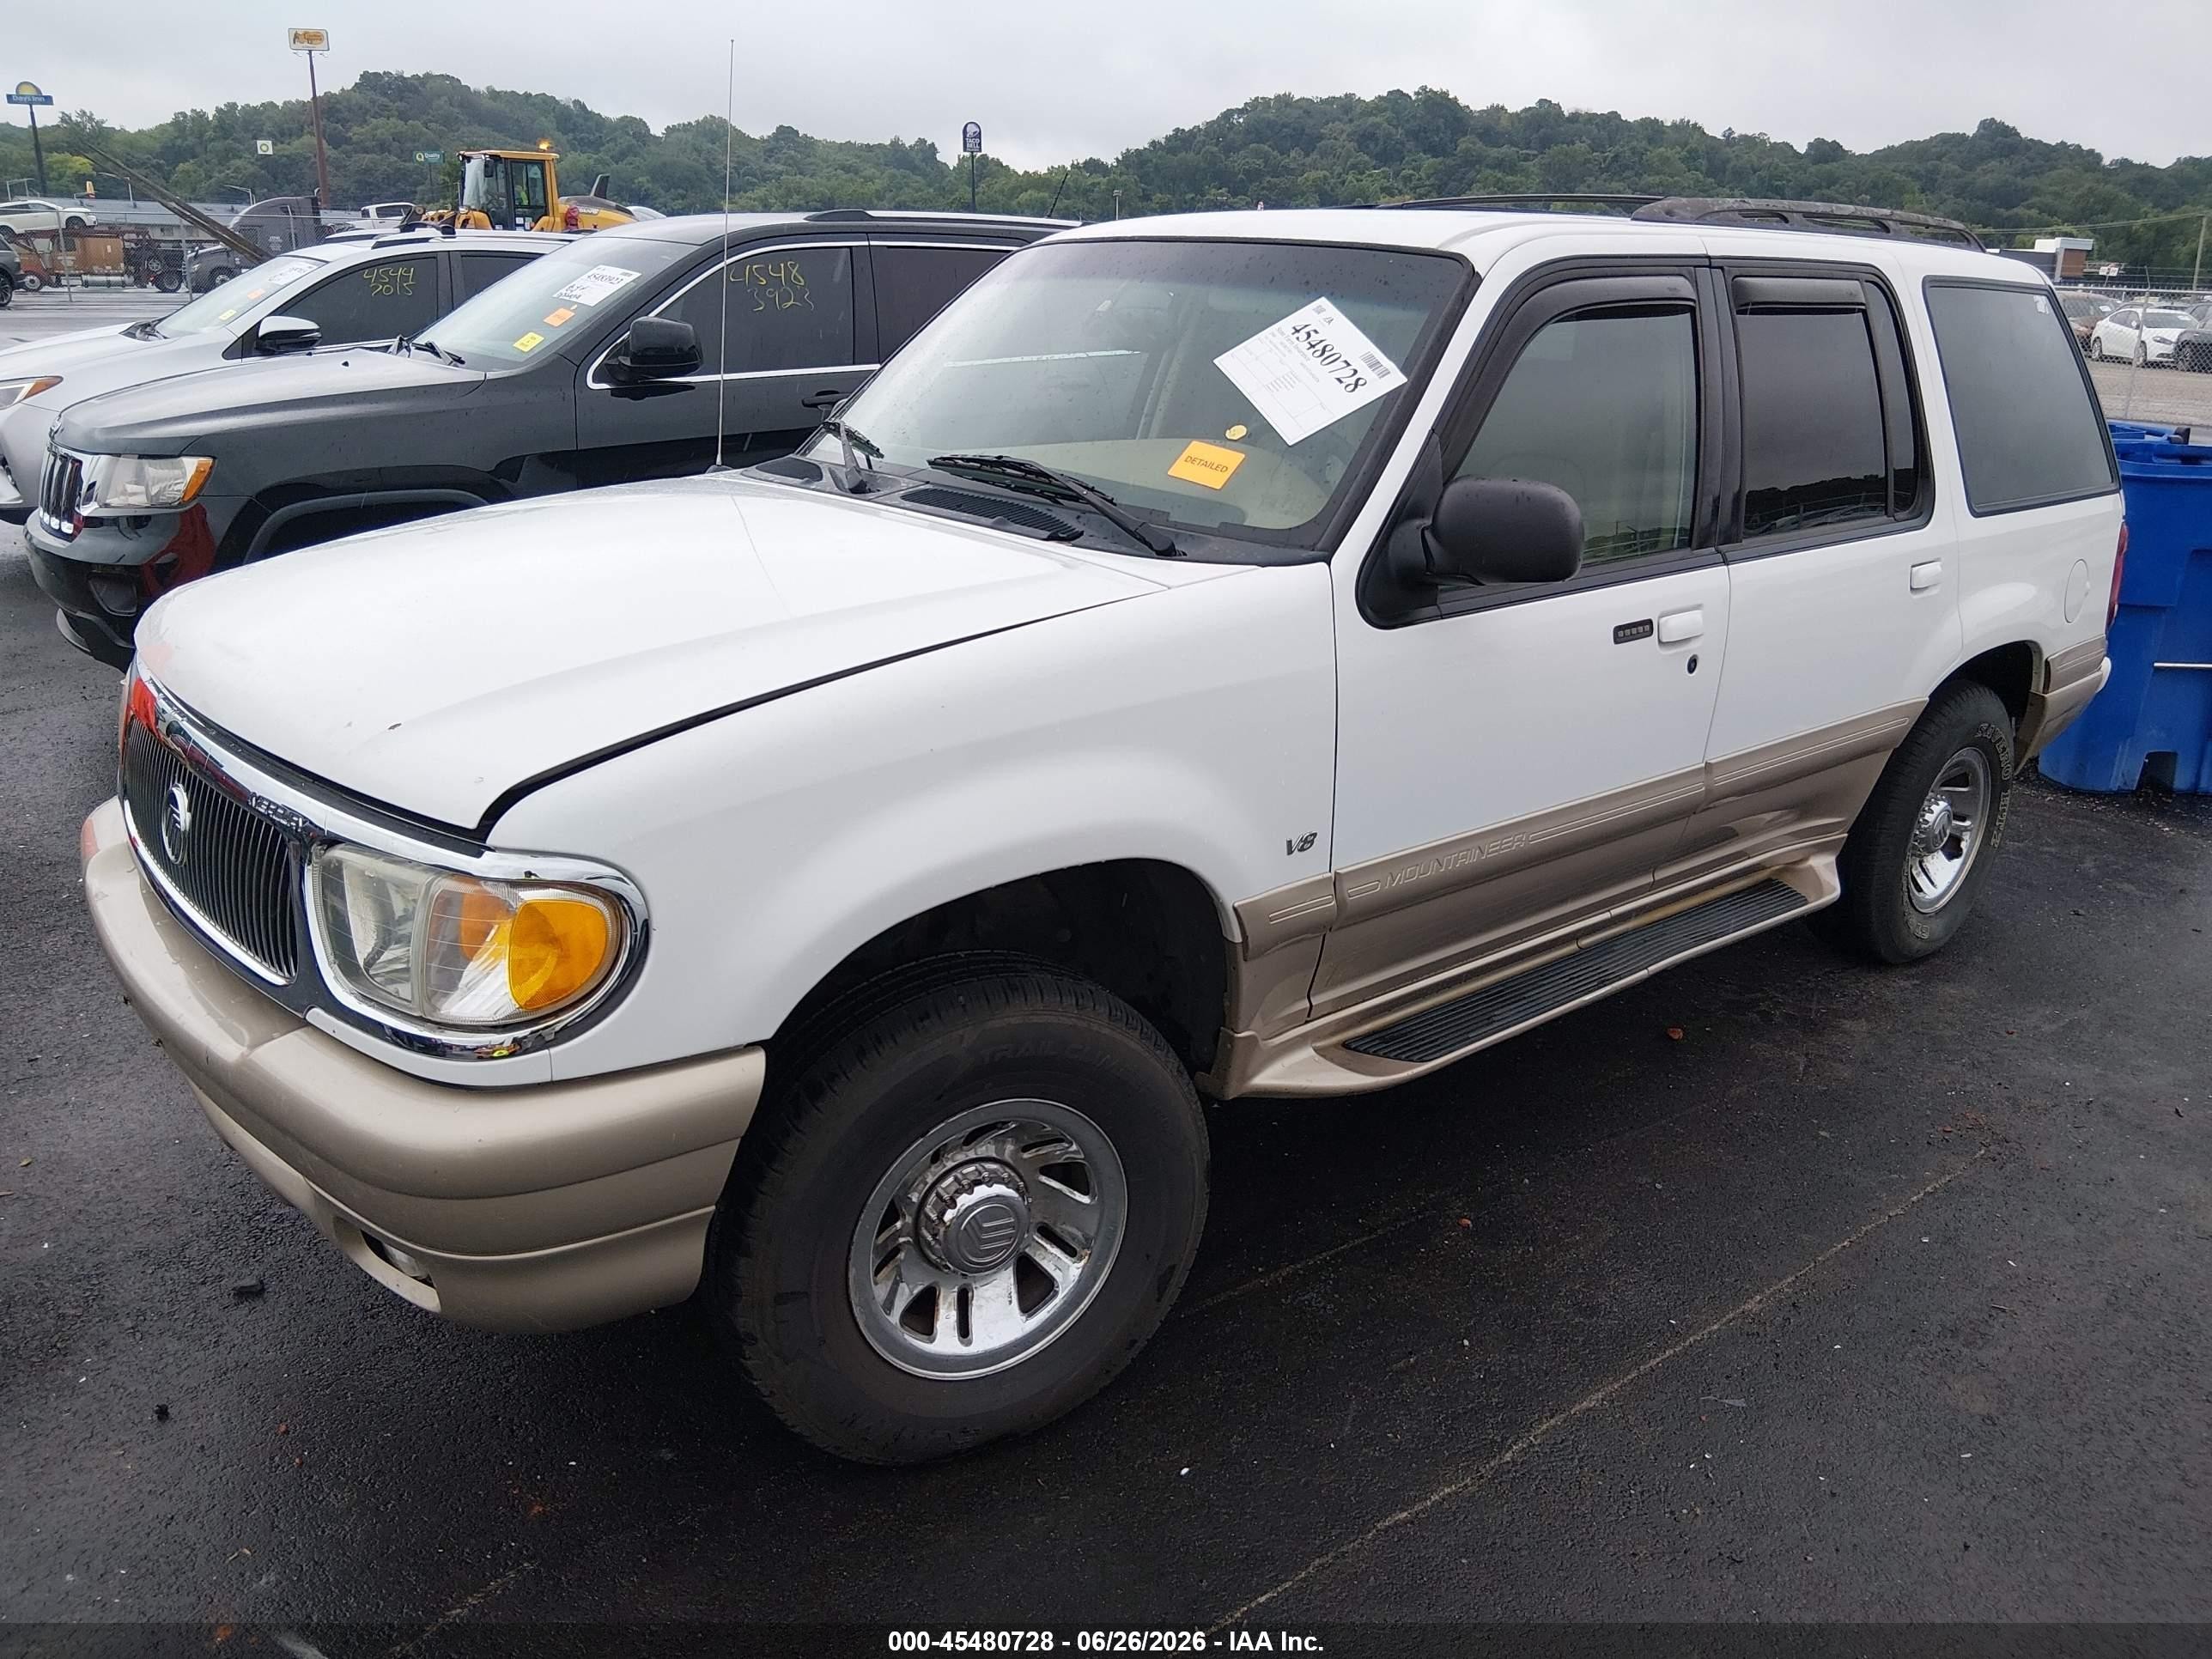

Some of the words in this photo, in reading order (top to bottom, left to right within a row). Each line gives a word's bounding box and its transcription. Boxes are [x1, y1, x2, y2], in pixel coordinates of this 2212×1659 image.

[363, 267, 415, 283] 4544
[729, 261, 805, 288] 4548
[747, 287, 815, 312] 3923
[1291, 323, 1368, 393] 45480728
[1184, 455, 1229, 473] DETAILED
[1286, 831, 1318, 856] V8
[1385, 832, 1526, 890] MOUNTAINEER
